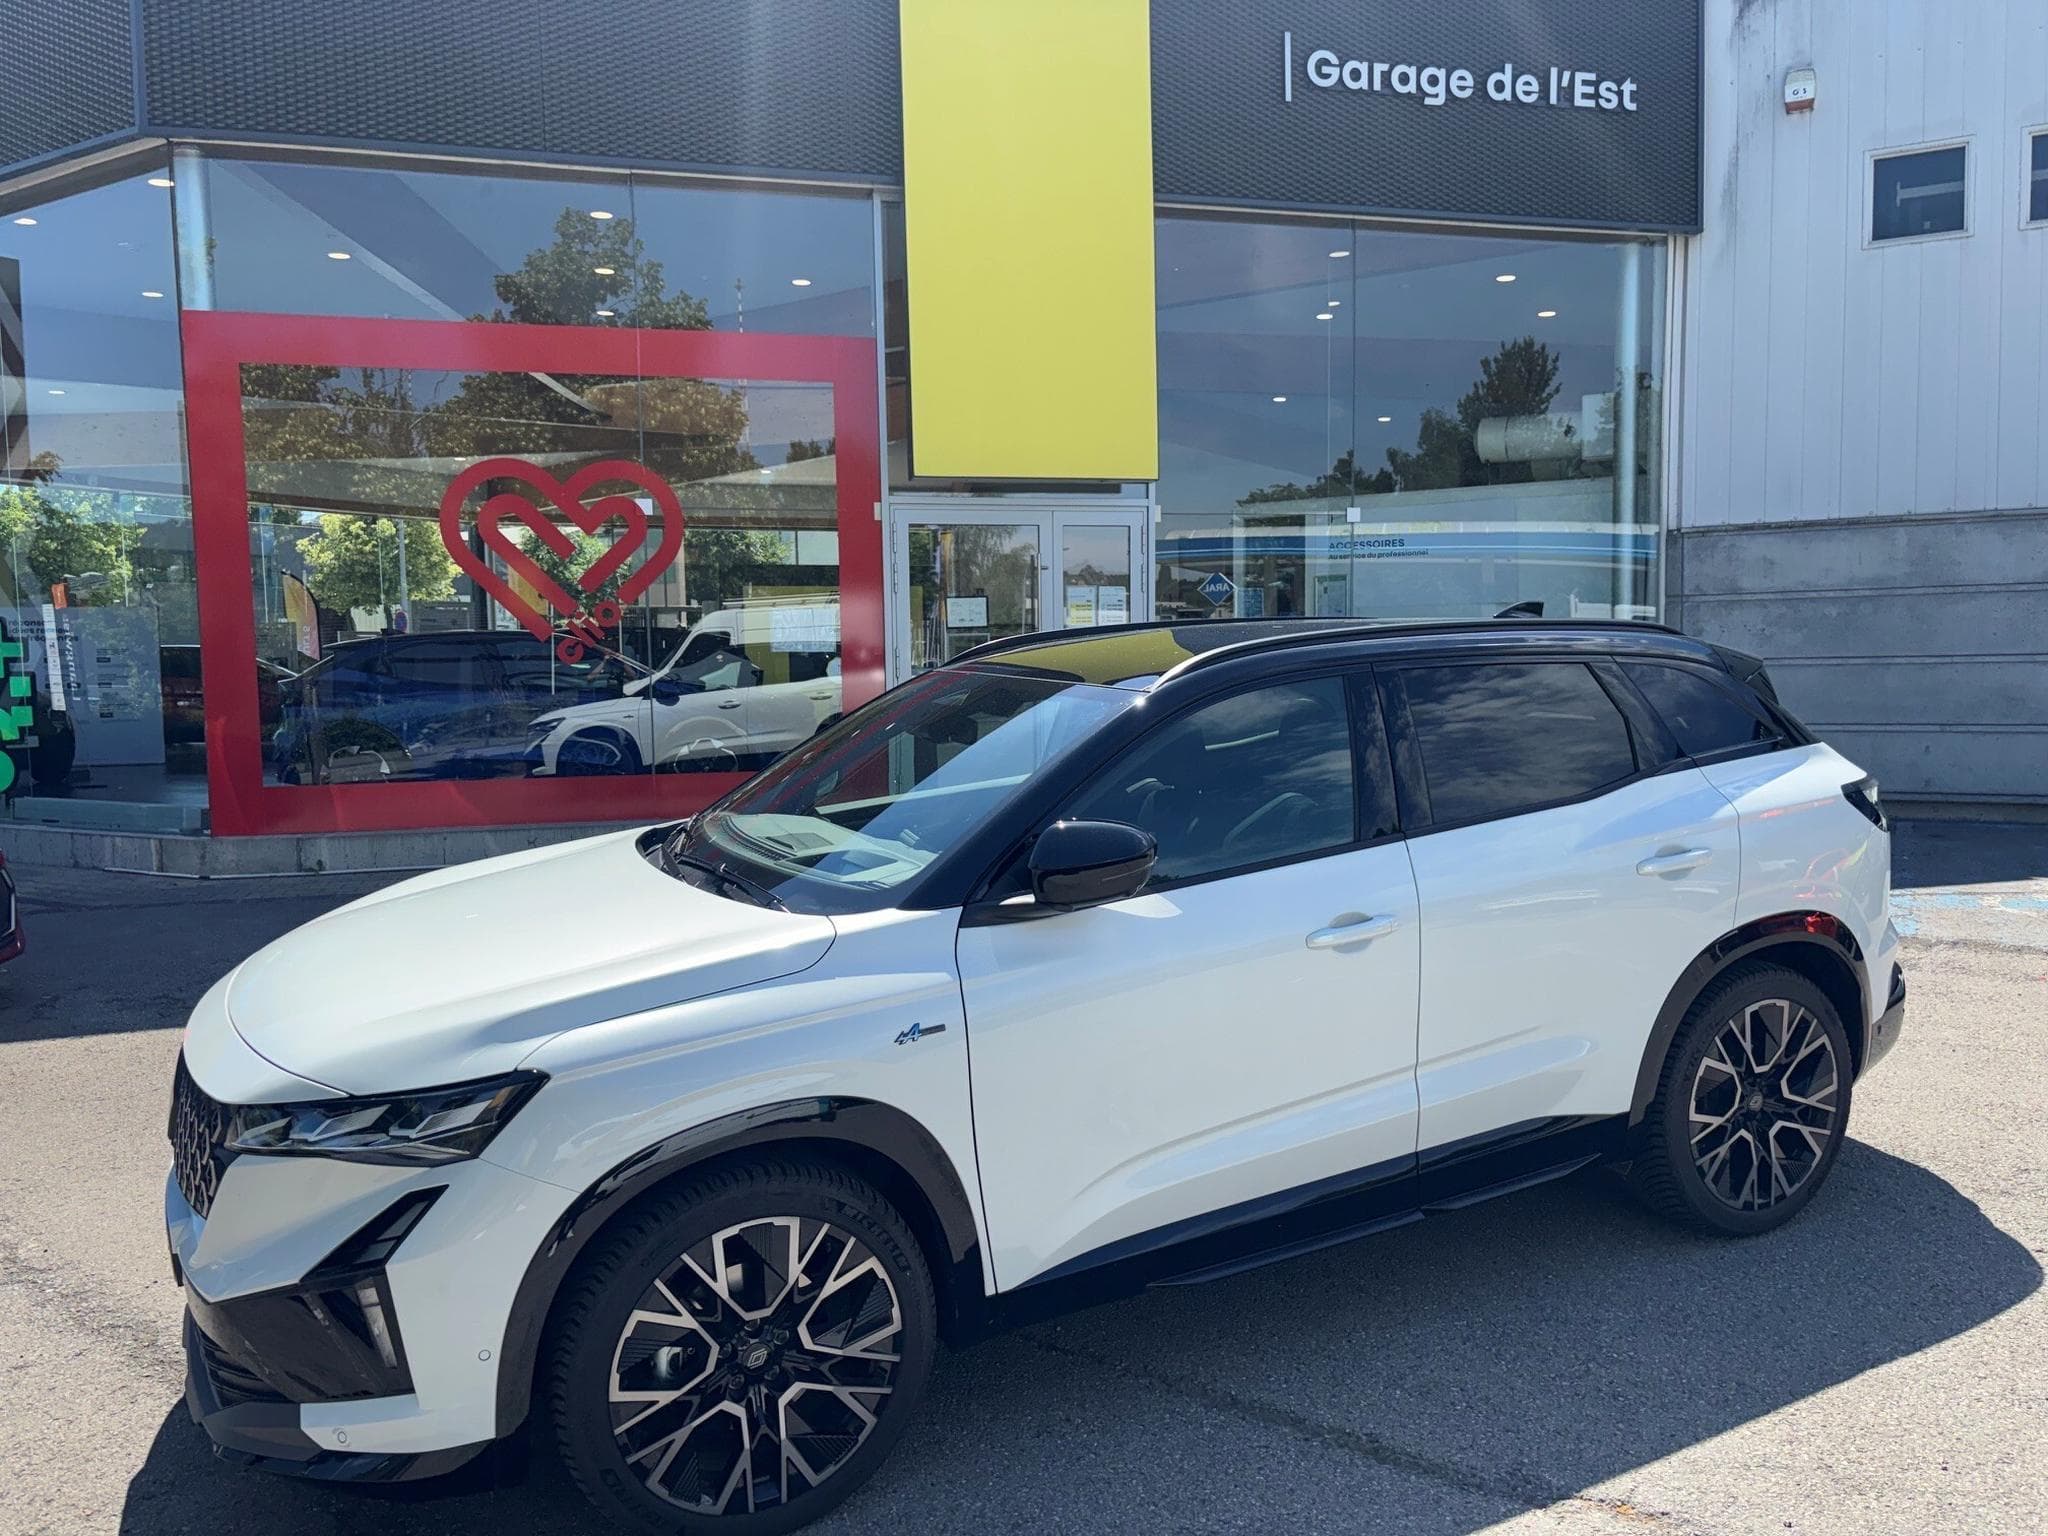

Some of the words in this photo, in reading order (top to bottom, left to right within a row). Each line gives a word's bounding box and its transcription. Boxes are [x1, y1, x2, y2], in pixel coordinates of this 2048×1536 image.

[1306, 49, 1475, 106] Garage
[1486, 63, 1540, 103] de
[1549, 66, 1637, 111] l'Est
[1329, 539, 1405, 549] ACCESSOIRES
[1377, 549, 1429, 558] professionnel
